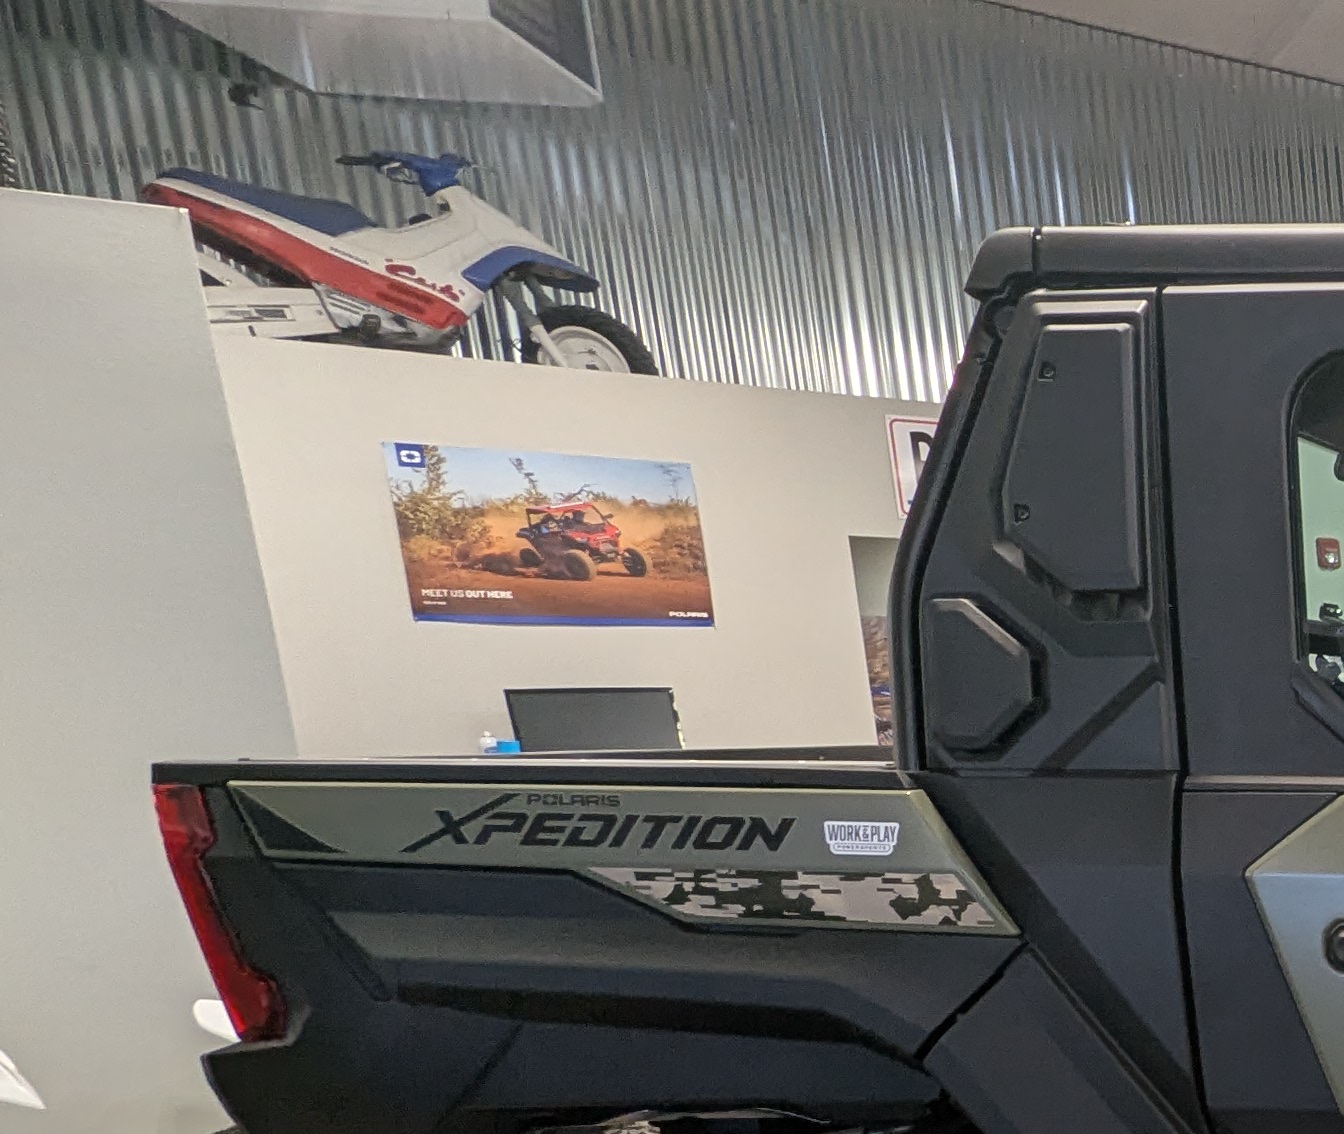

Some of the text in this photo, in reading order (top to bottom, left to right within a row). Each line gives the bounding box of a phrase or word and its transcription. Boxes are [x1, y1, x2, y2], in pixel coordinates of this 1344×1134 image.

[420, 588, 514, 599] MEET US OUT HERE
[526, 794, 621, 808] POLARIS
[400, 792, 798, 854] XPEDITION
